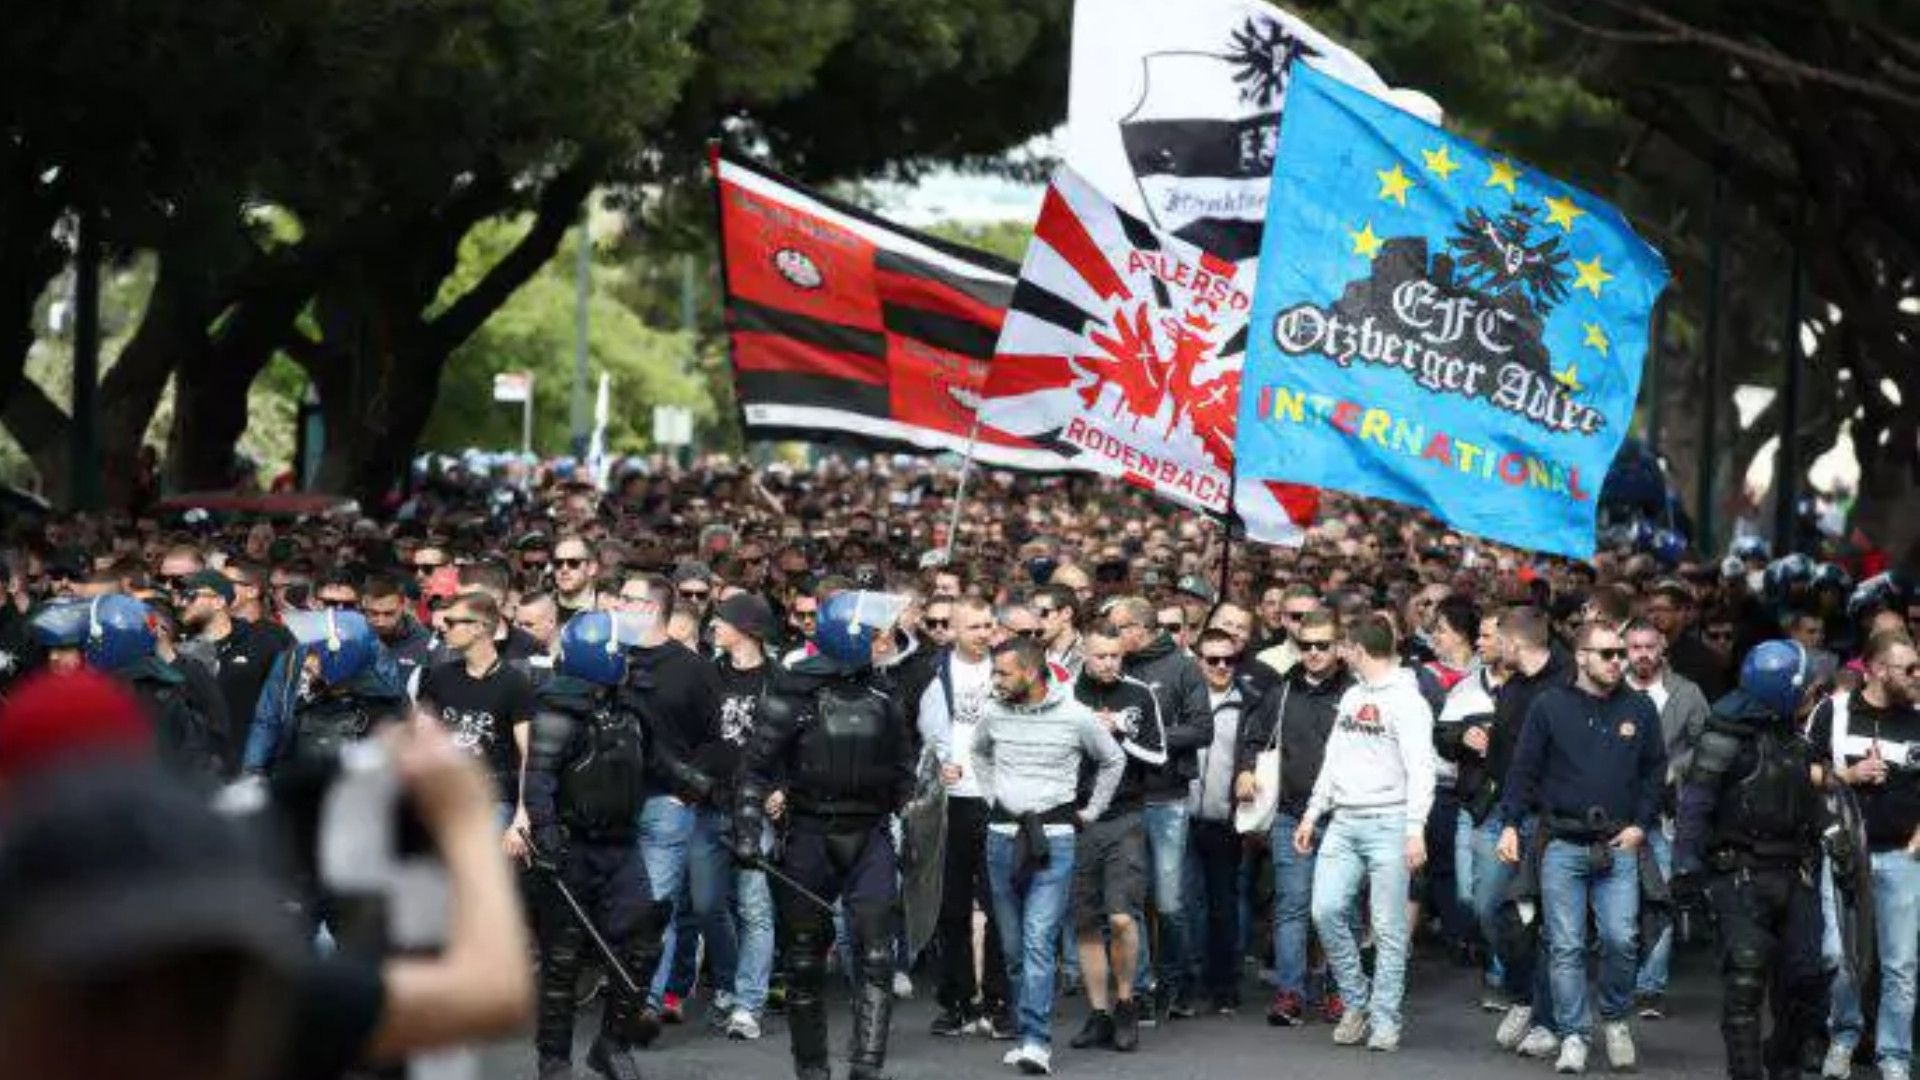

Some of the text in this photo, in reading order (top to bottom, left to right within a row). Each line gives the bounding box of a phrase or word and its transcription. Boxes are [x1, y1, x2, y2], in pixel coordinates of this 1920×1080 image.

[1275, 304, 1606, 432] Otzberger Adler
[1391, 279, 1518, 354] EFC
[1257, 384, 1590, 501] INTERNATIONAL
